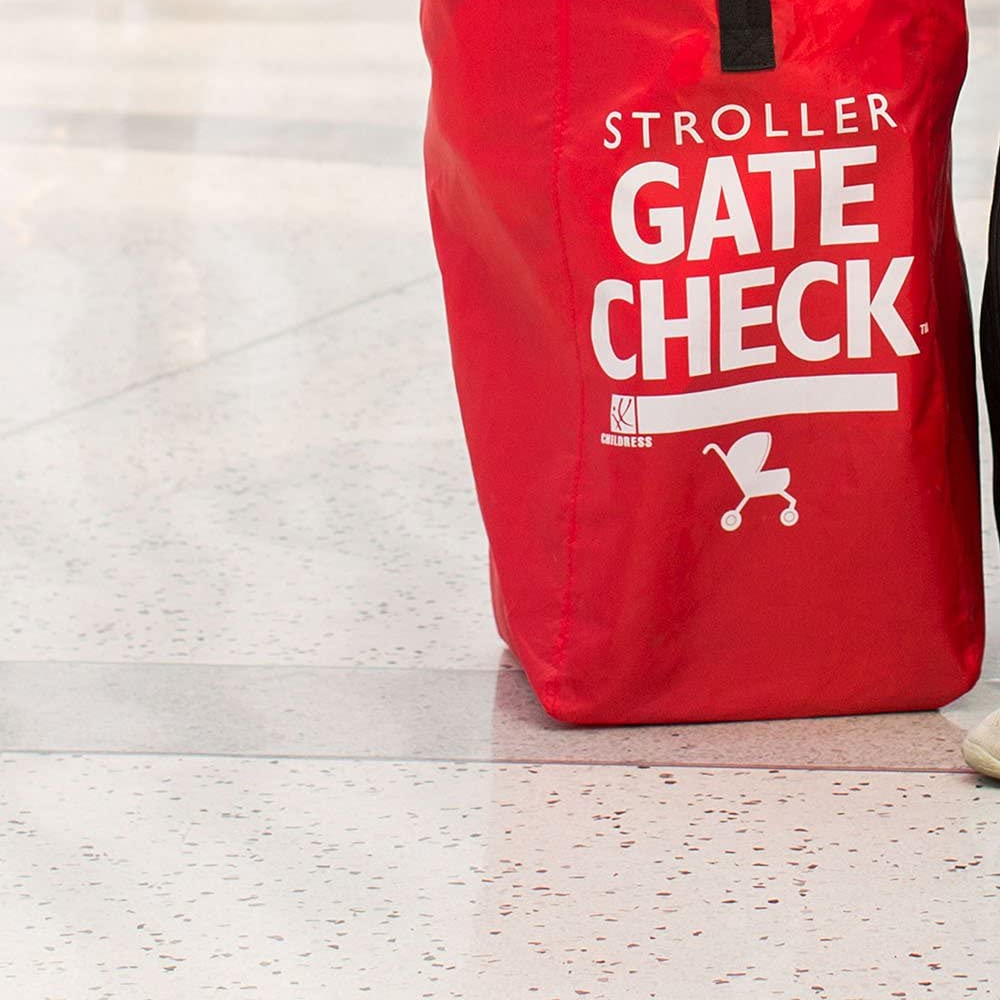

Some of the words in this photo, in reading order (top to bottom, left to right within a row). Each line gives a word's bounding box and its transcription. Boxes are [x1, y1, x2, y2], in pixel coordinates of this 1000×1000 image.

[603, 93, 898, 150] STROLLER
[611, 145, 880, 265] GATE
[590, 256, 921, 381] CHECK
[600, 432, 653, 448] CHILDRESS
